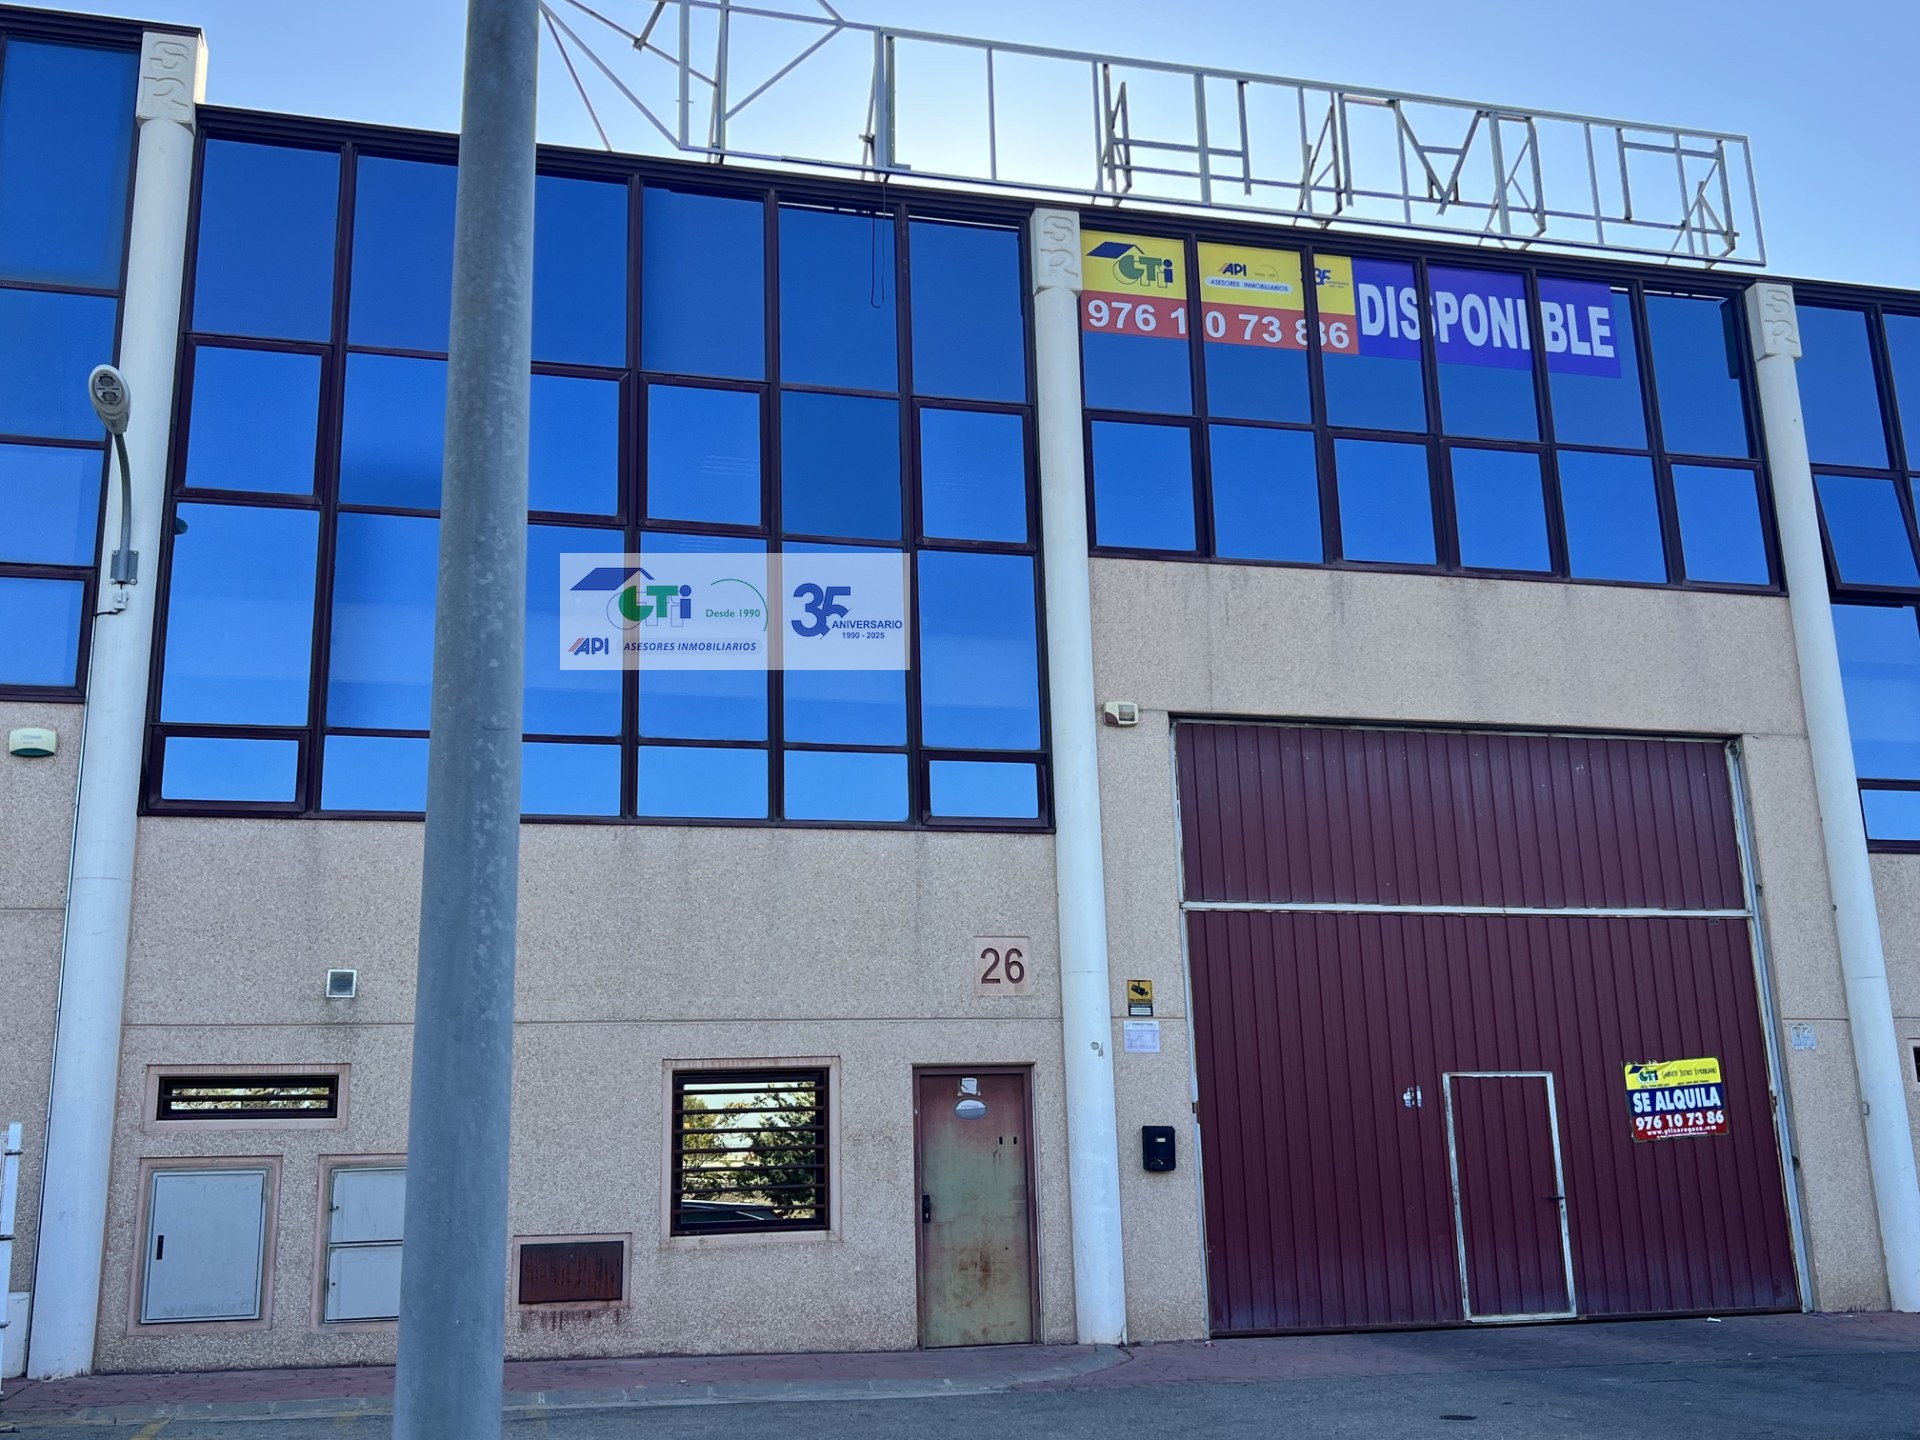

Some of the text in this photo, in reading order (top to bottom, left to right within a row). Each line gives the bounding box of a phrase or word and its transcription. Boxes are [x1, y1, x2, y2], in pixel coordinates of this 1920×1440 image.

[1222, 262, 1247, 277] API
[1210, 279, 1288, 292] ASESORES INMOBILIARIOS
[1087, 299, 1157, 332] 976
[1238, 313, 1283, 343] 73
[1295, 319, 1350, 349] 86
[1358, 283, 1615, 358] DISPONIBLE
[980, 947, 1025, 985] 26
[1632, 1086, 1722, 1114] SE ALQUILA
[1635, 1110, 1724, 1131] 976 10 73 86
